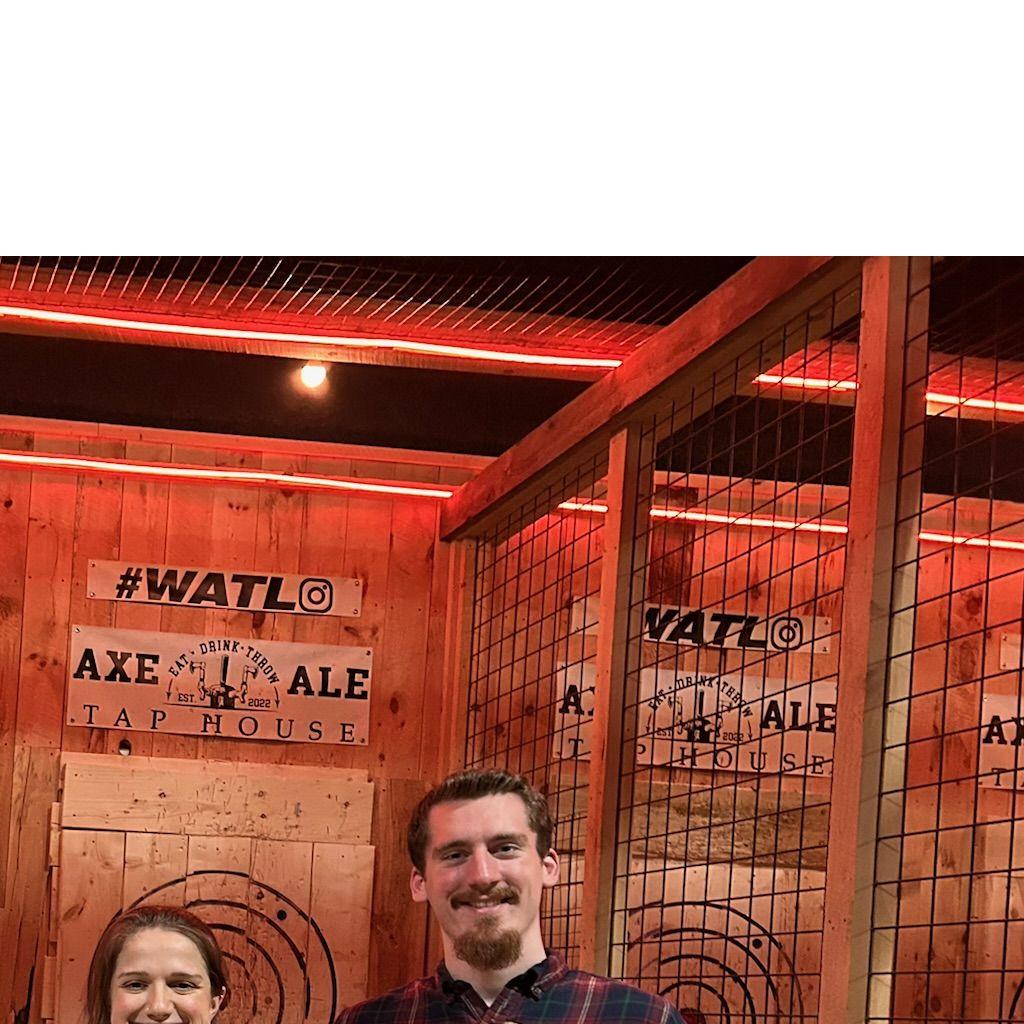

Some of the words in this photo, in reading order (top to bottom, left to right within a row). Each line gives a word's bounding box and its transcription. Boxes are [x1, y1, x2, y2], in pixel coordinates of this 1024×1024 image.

[115, 567, 296, 611] #WATL
[73, 648, 160, 685] AXE
[287, 665, 369, 699] ALE
[169, 653, 189, 677] EAT
[199, 640, 240, 654] DRINK
[246, 646, 280, 684] THROW
[676, 675, 713, 689] DRNK
[248, 699, 271, 708] 2022
[761, 700, 836, 733] ALE
[83, 705, 166, 730] TAP
[201, 713, 355, 743] HOUSE
[679, 747, 824, 774] HOUSE
